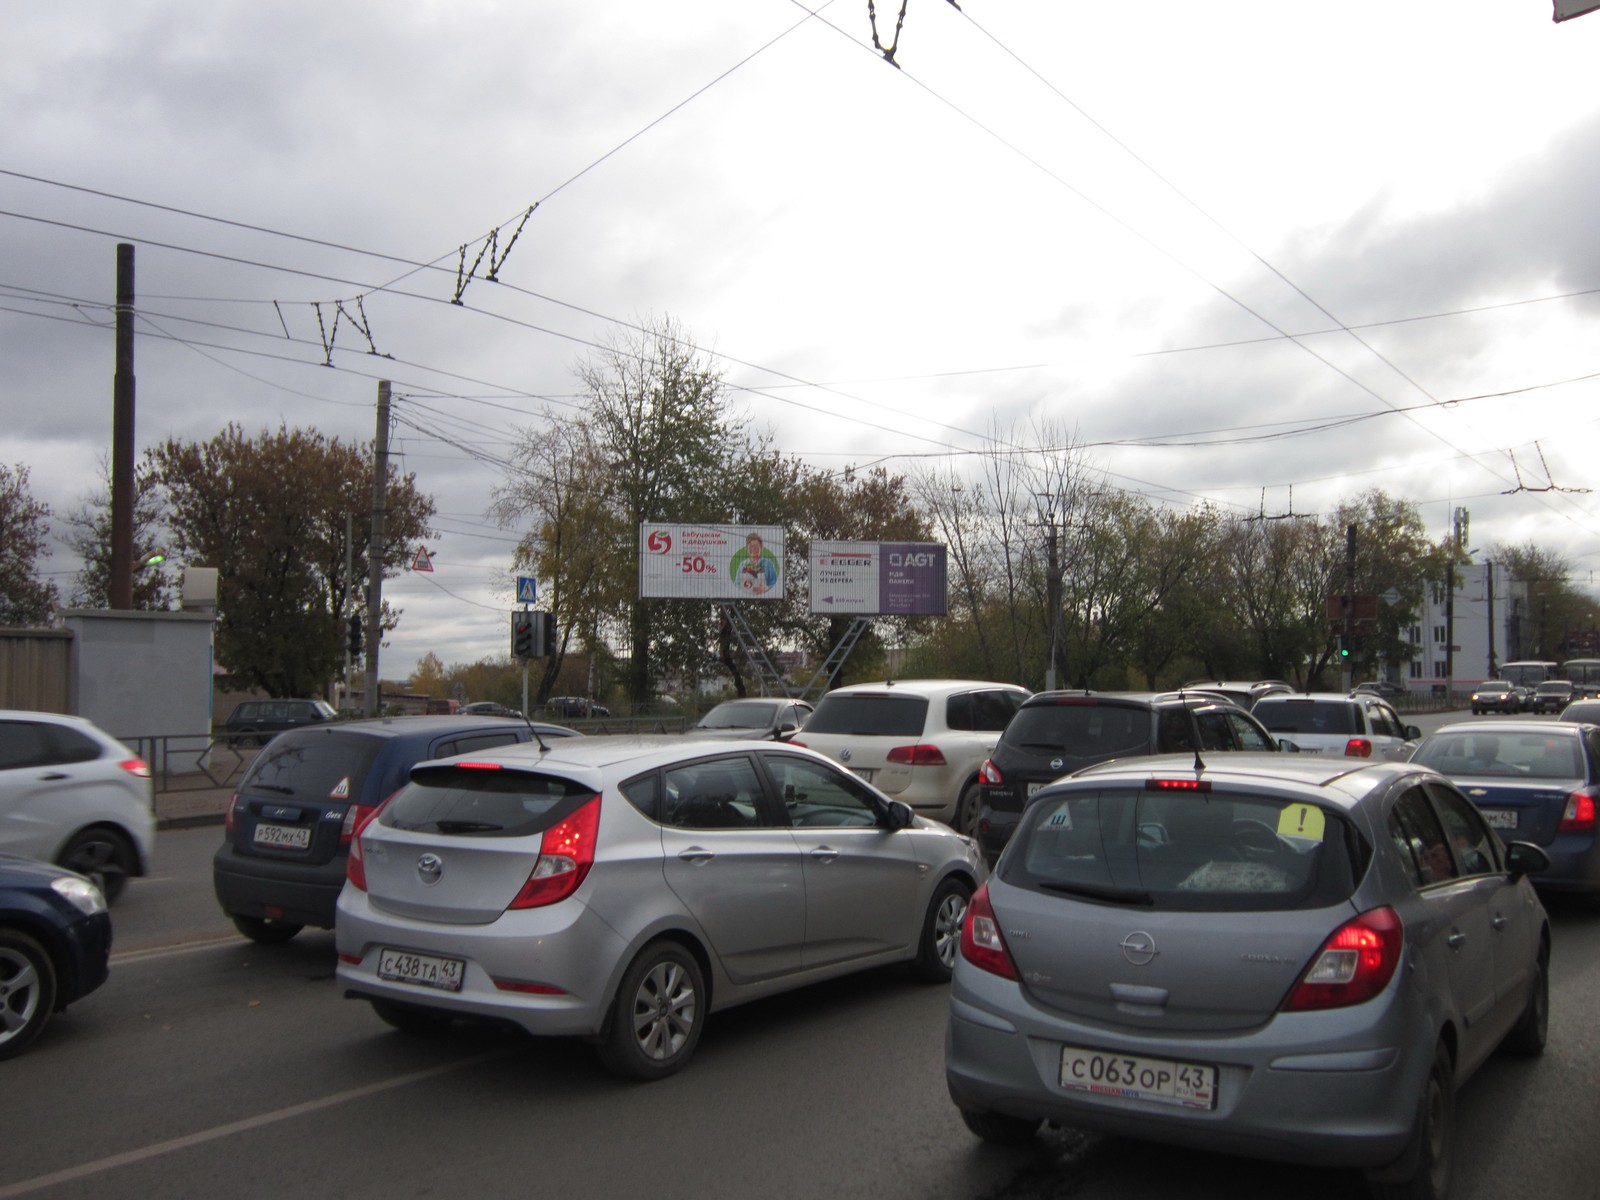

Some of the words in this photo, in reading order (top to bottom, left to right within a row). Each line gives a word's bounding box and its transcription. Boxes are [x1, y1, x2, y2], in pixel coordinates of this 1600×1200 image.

[675, 556, 717, 574] -50%
[904, 552, 936, 567] AGT
[1072, 1055, 1171, 1091] С063ОР
